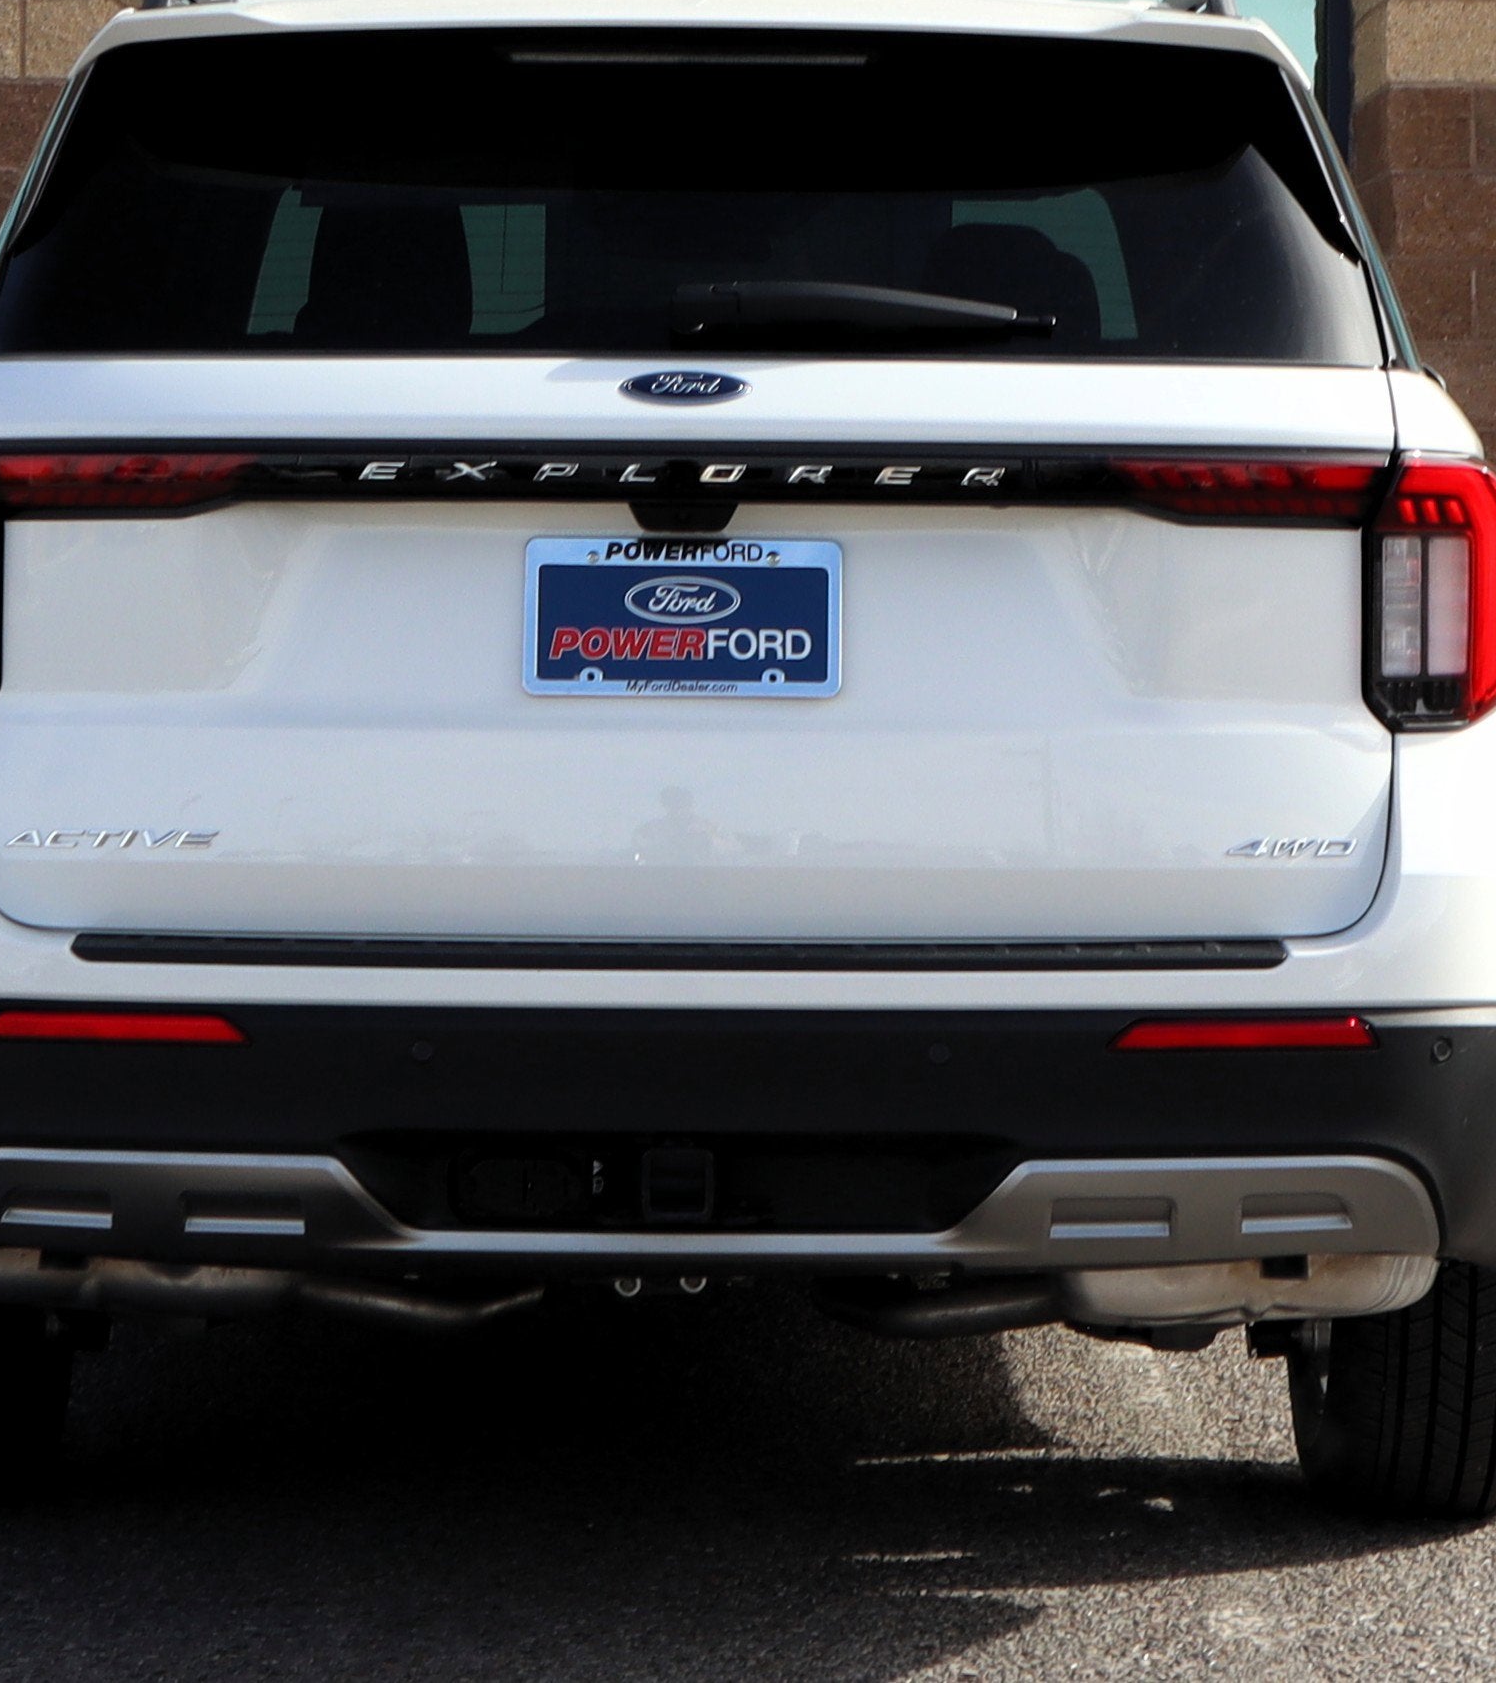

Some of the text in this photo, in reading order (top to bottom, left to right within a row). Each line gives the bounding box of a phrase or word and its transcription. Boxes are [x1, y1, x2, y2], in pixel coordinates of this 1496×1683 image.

[651, 374, 721, 394] Ford
[358, 461, 1006, 487] EXPLORER
[648, 583, 717, 613] Ford
[626, 678, 739, 695] MyFordDealer.com
[7, 829, 220, 848] ACTIVE
[1226, 836, 1358, 857] 4WD
